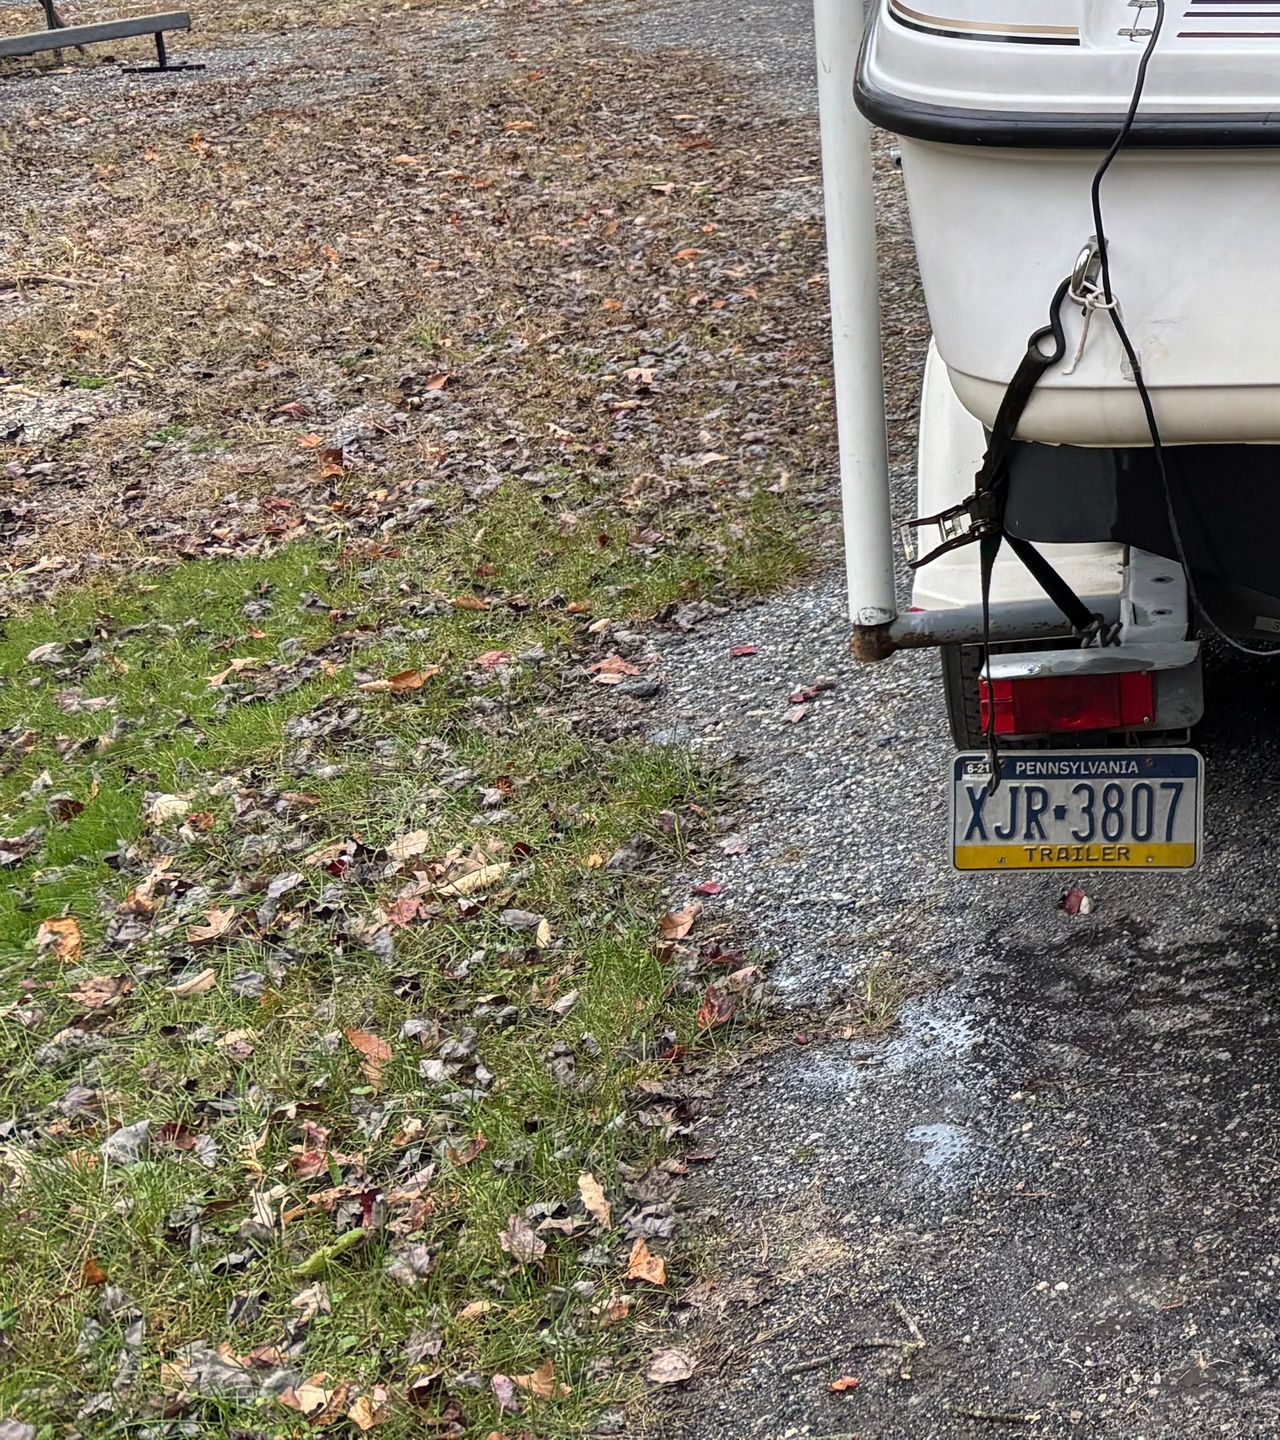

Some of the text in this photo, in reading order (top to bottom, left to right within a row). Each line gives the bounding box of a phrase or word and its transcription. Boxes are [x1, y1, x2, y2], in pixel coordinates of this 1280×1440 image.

[967, 761, 1138, 775] 6-21 PENNSYLVANIA
[1023, 846, 1130, 863] TRAILER
